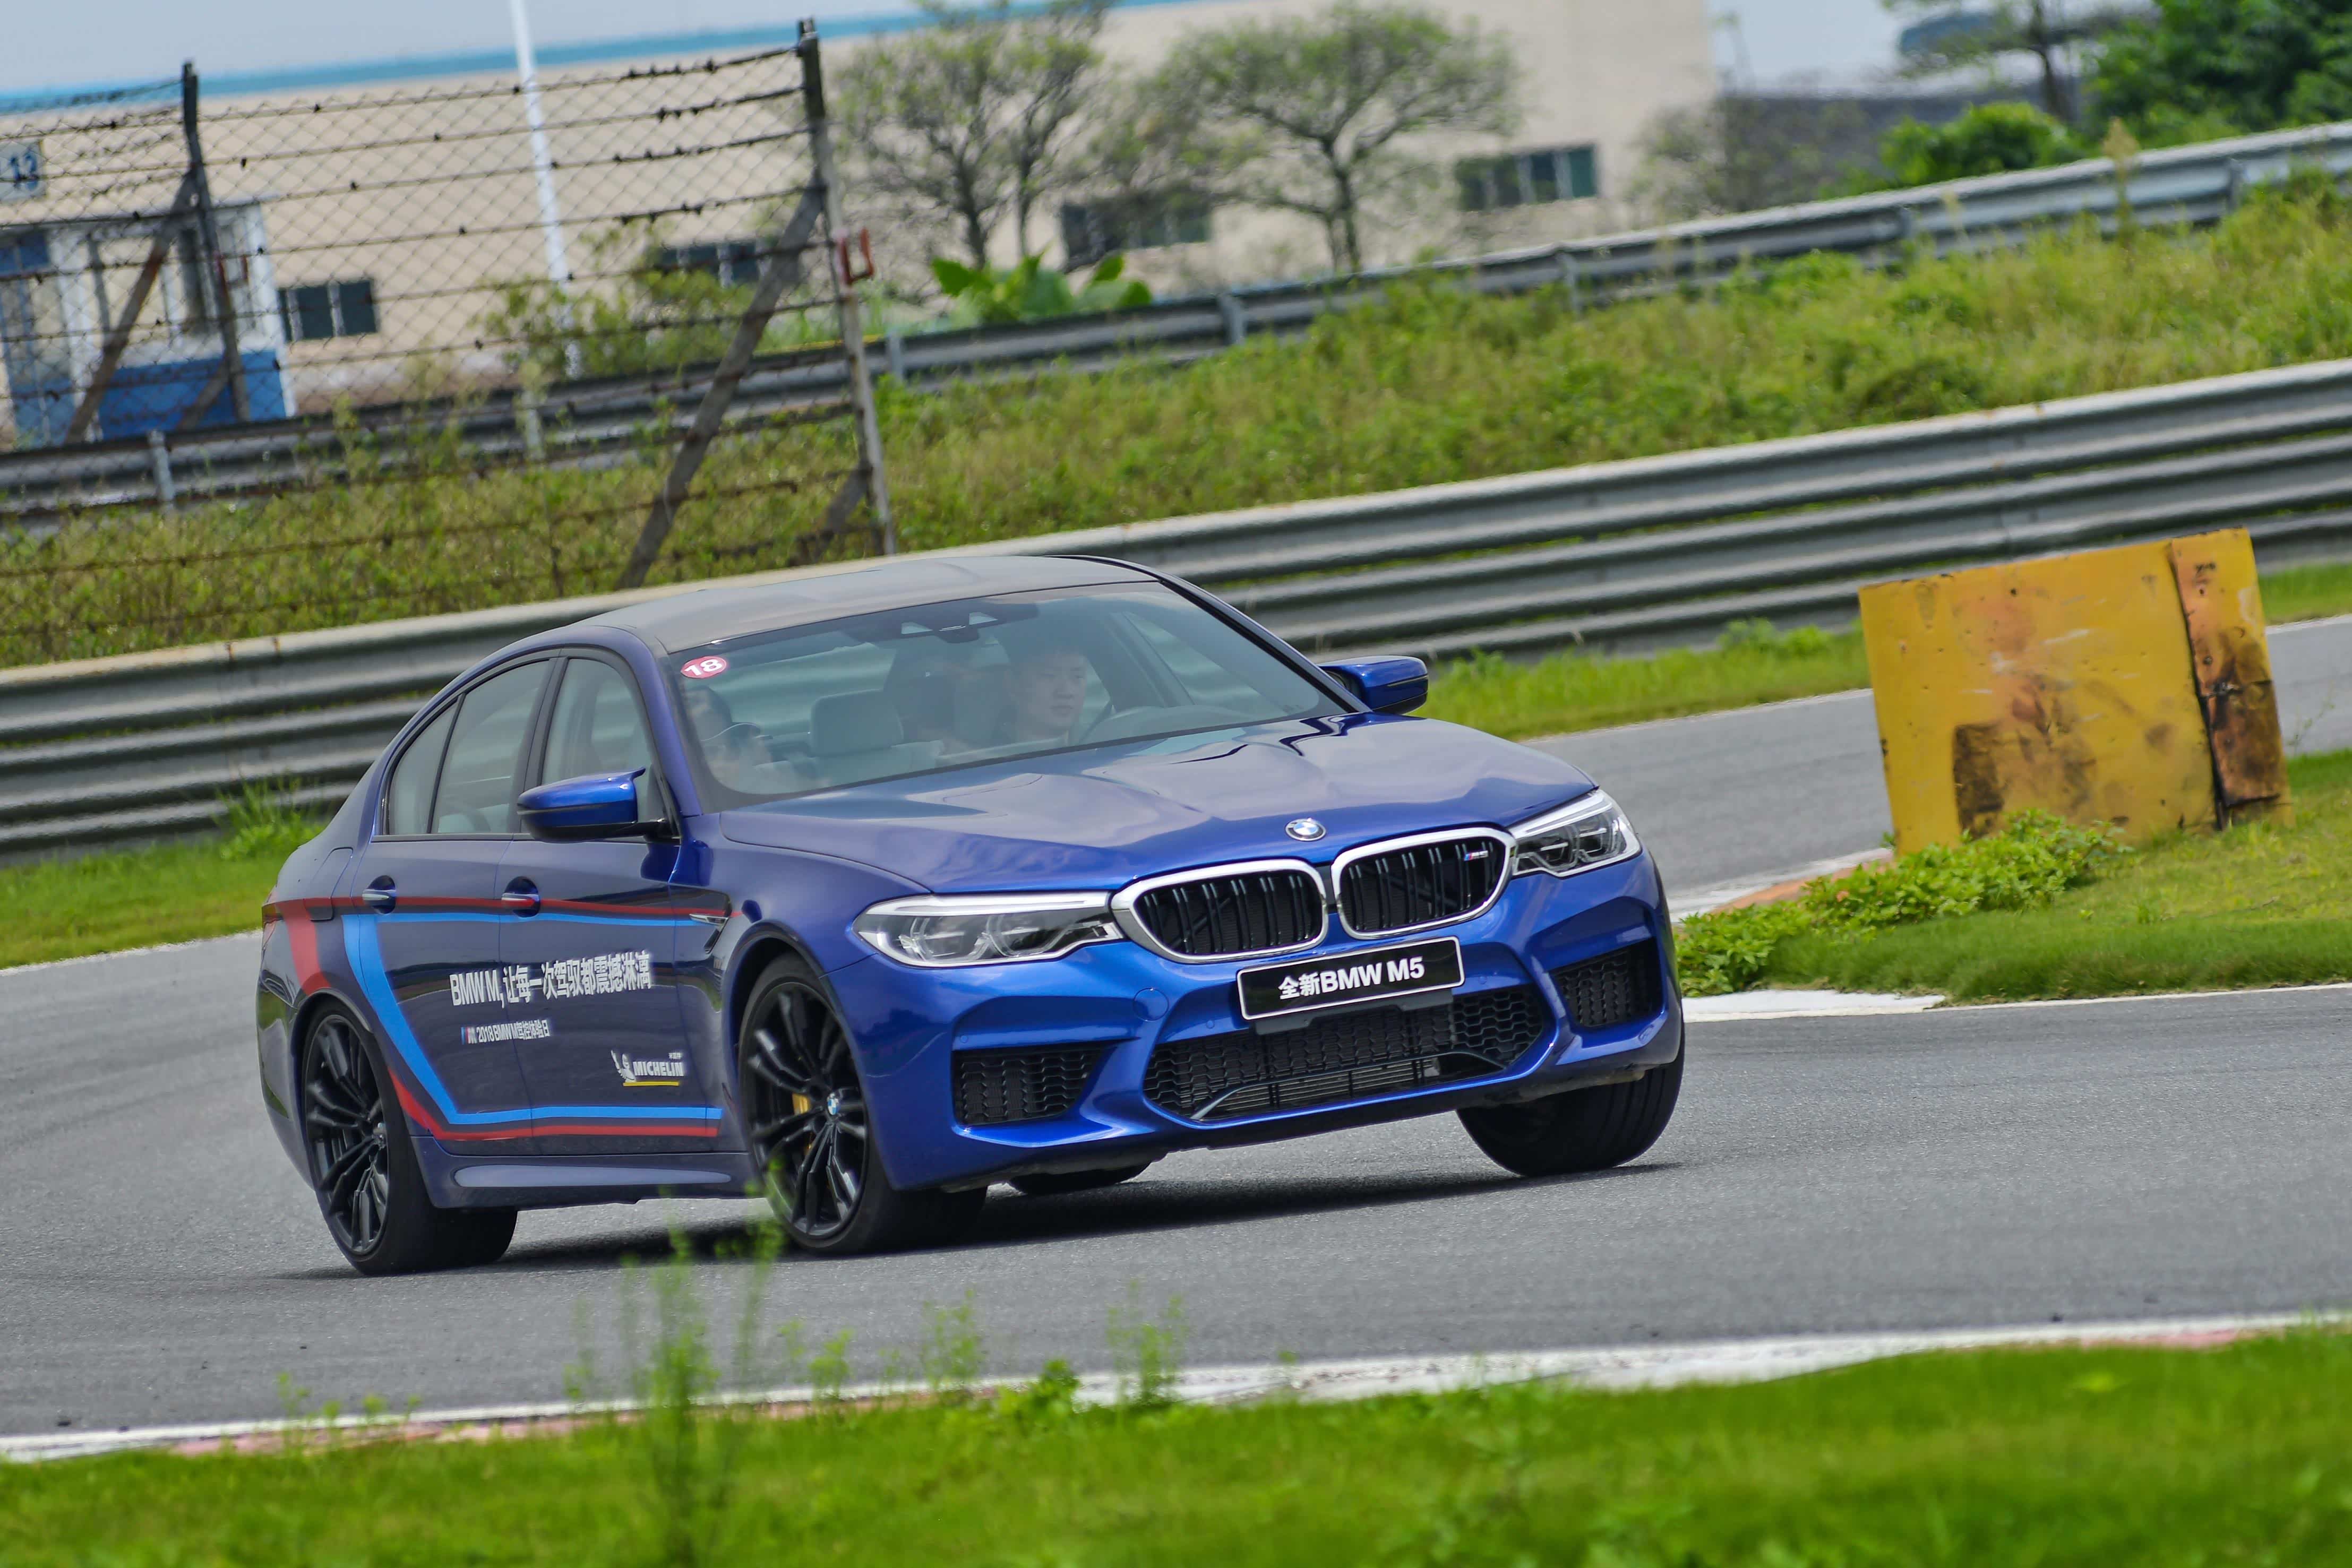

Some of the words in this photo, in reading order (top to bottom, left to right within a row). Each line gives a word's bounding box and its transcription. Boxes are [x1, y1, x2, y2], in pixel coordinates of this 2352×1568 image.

[684, 659, 723, 676] 18
[449, 970, 485, 1006] BMW
[1278, 962, 1382, 1000] 全新BMW
[1386, 956, 1425, 982] M5
[633, 1061, 684, 1076] MICHELIN
